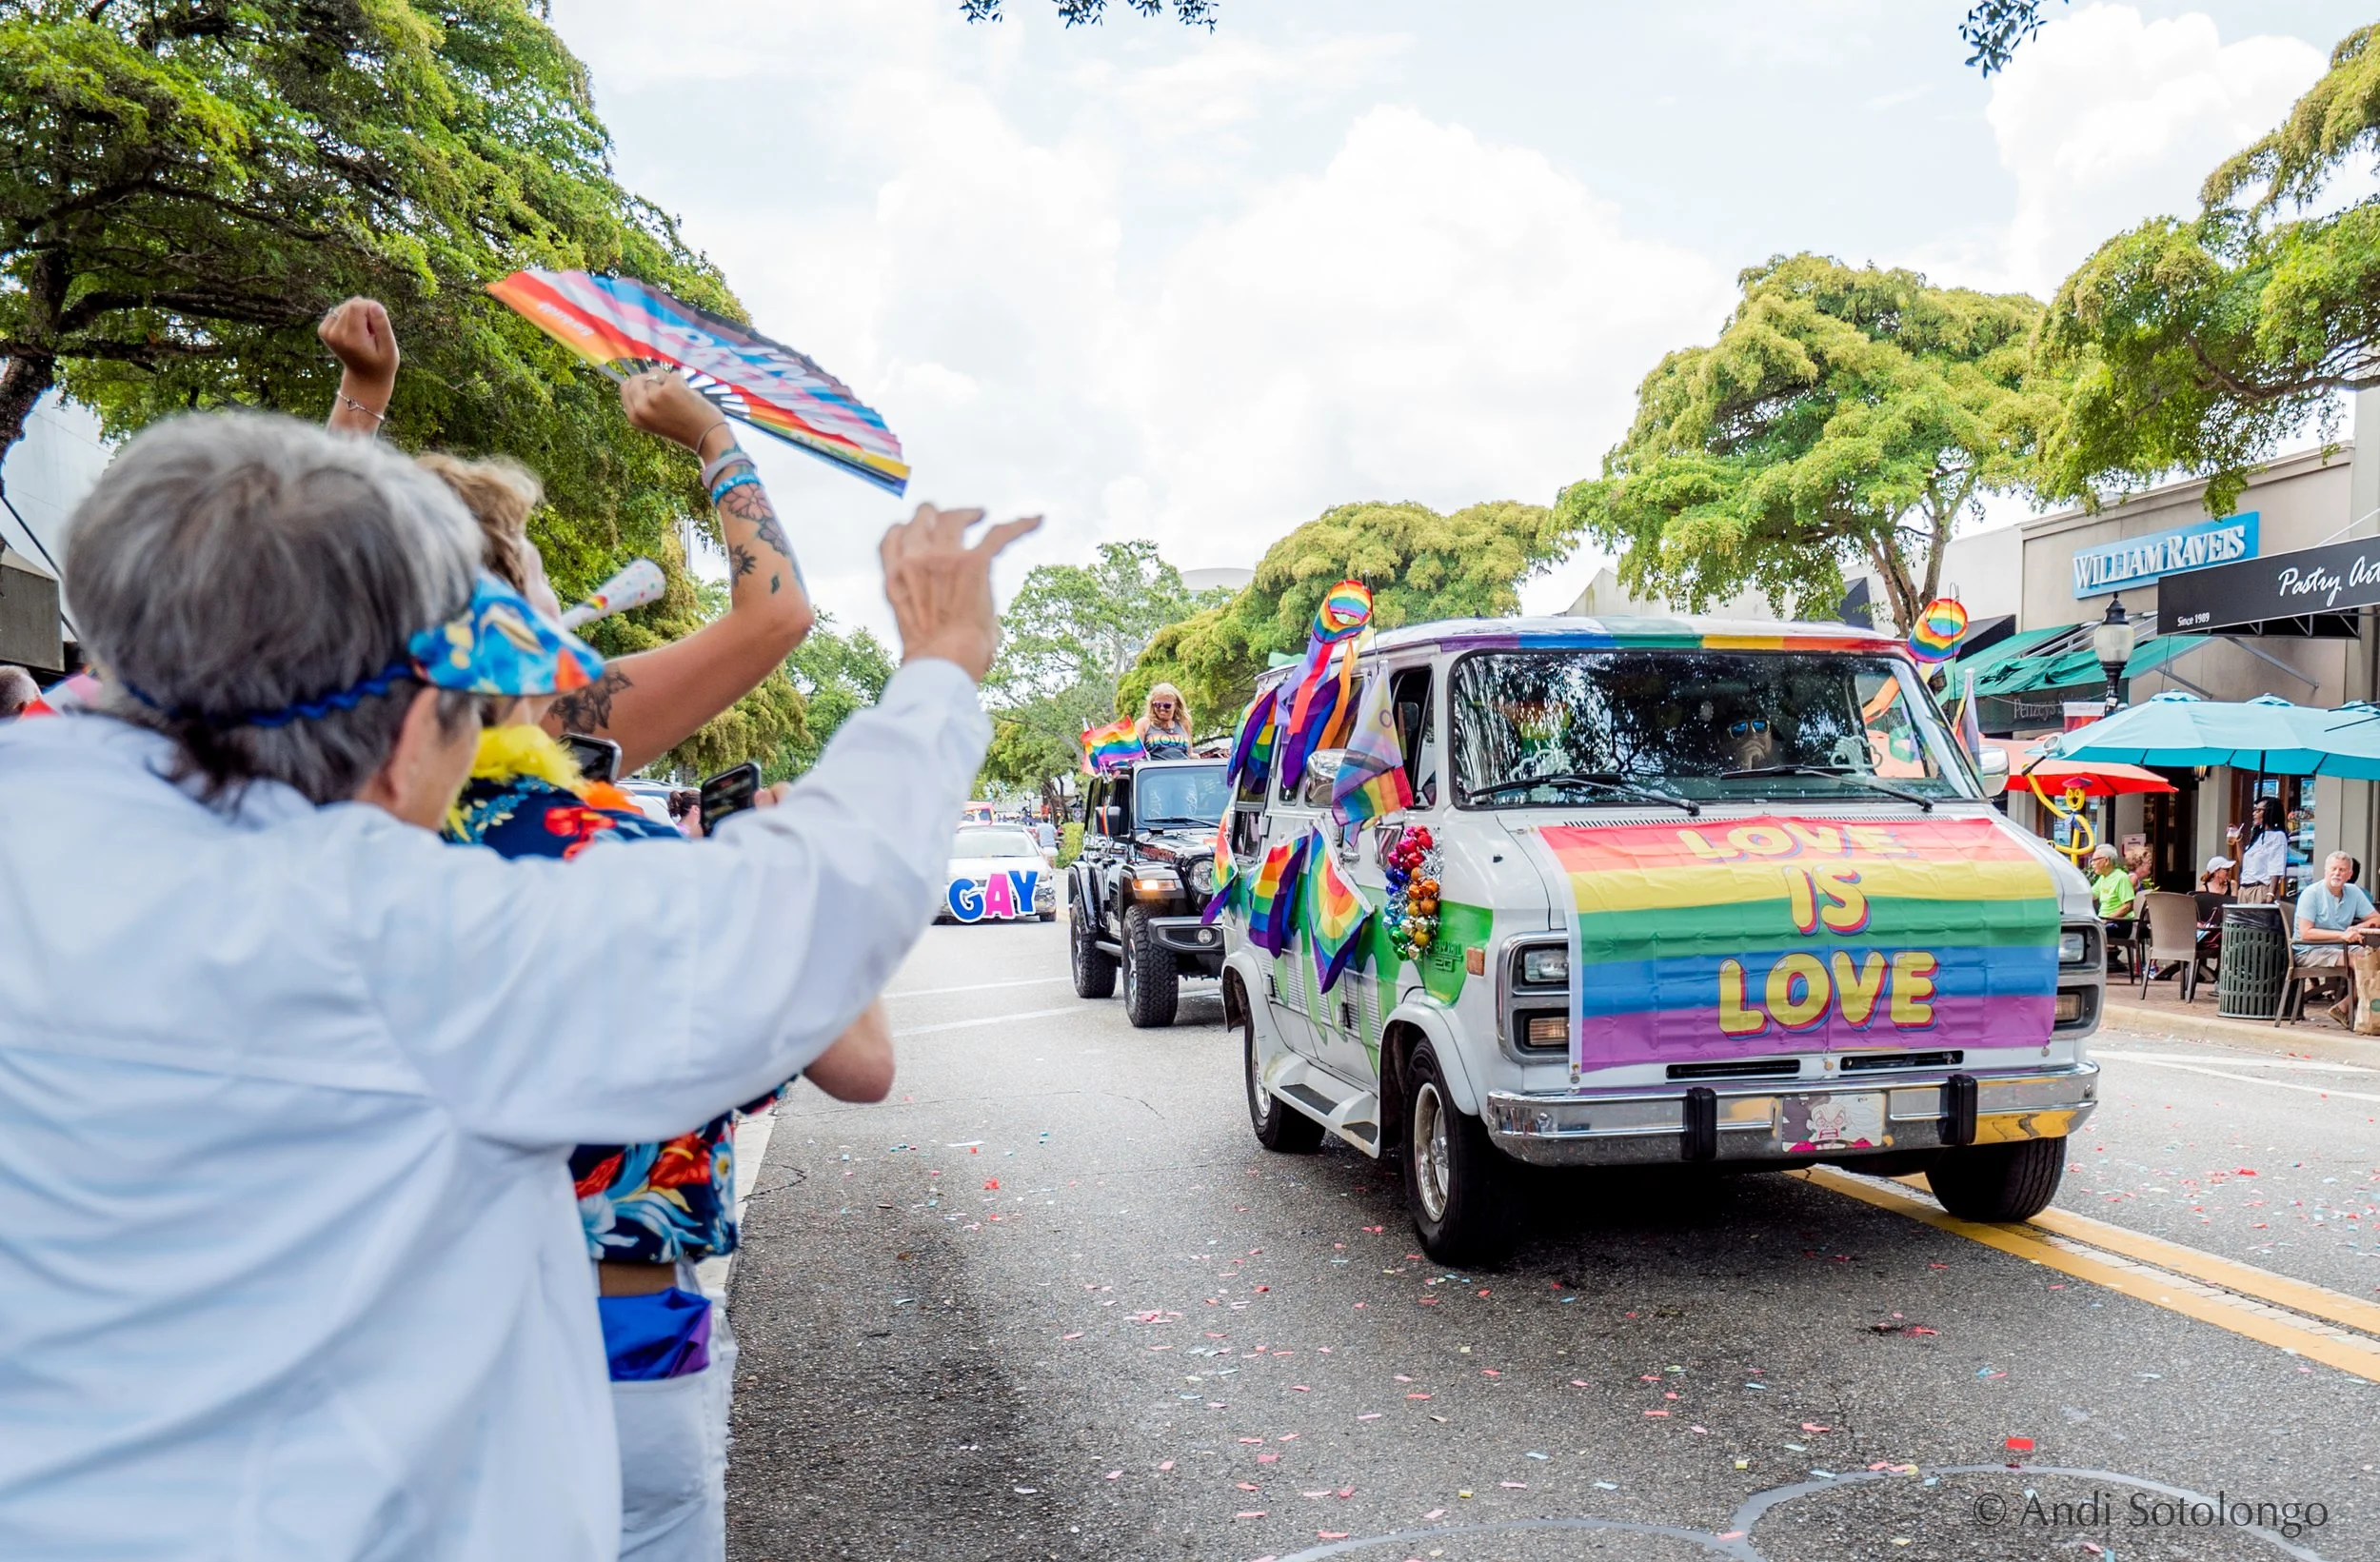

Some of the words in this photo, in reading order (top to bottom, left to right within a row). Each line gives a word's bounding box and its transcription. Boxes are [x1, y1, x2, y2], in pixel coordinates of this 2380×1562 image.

[2073, 541, 2164, 589] WILLIAM
[2165, 524, 2245, 570] RAVEIS
[2278, 566, 2342, 607] Pastry
[2177, 615, 2193, 627] Since
[2194, 612, 2210, 623] 1989
[1676, 822, 1918, 862] LOVE
[947, 869, 1039, 923] GAY
[1782, 864, 1872, 937] IS
[1717, 950, 1940, 1040] LOVE
